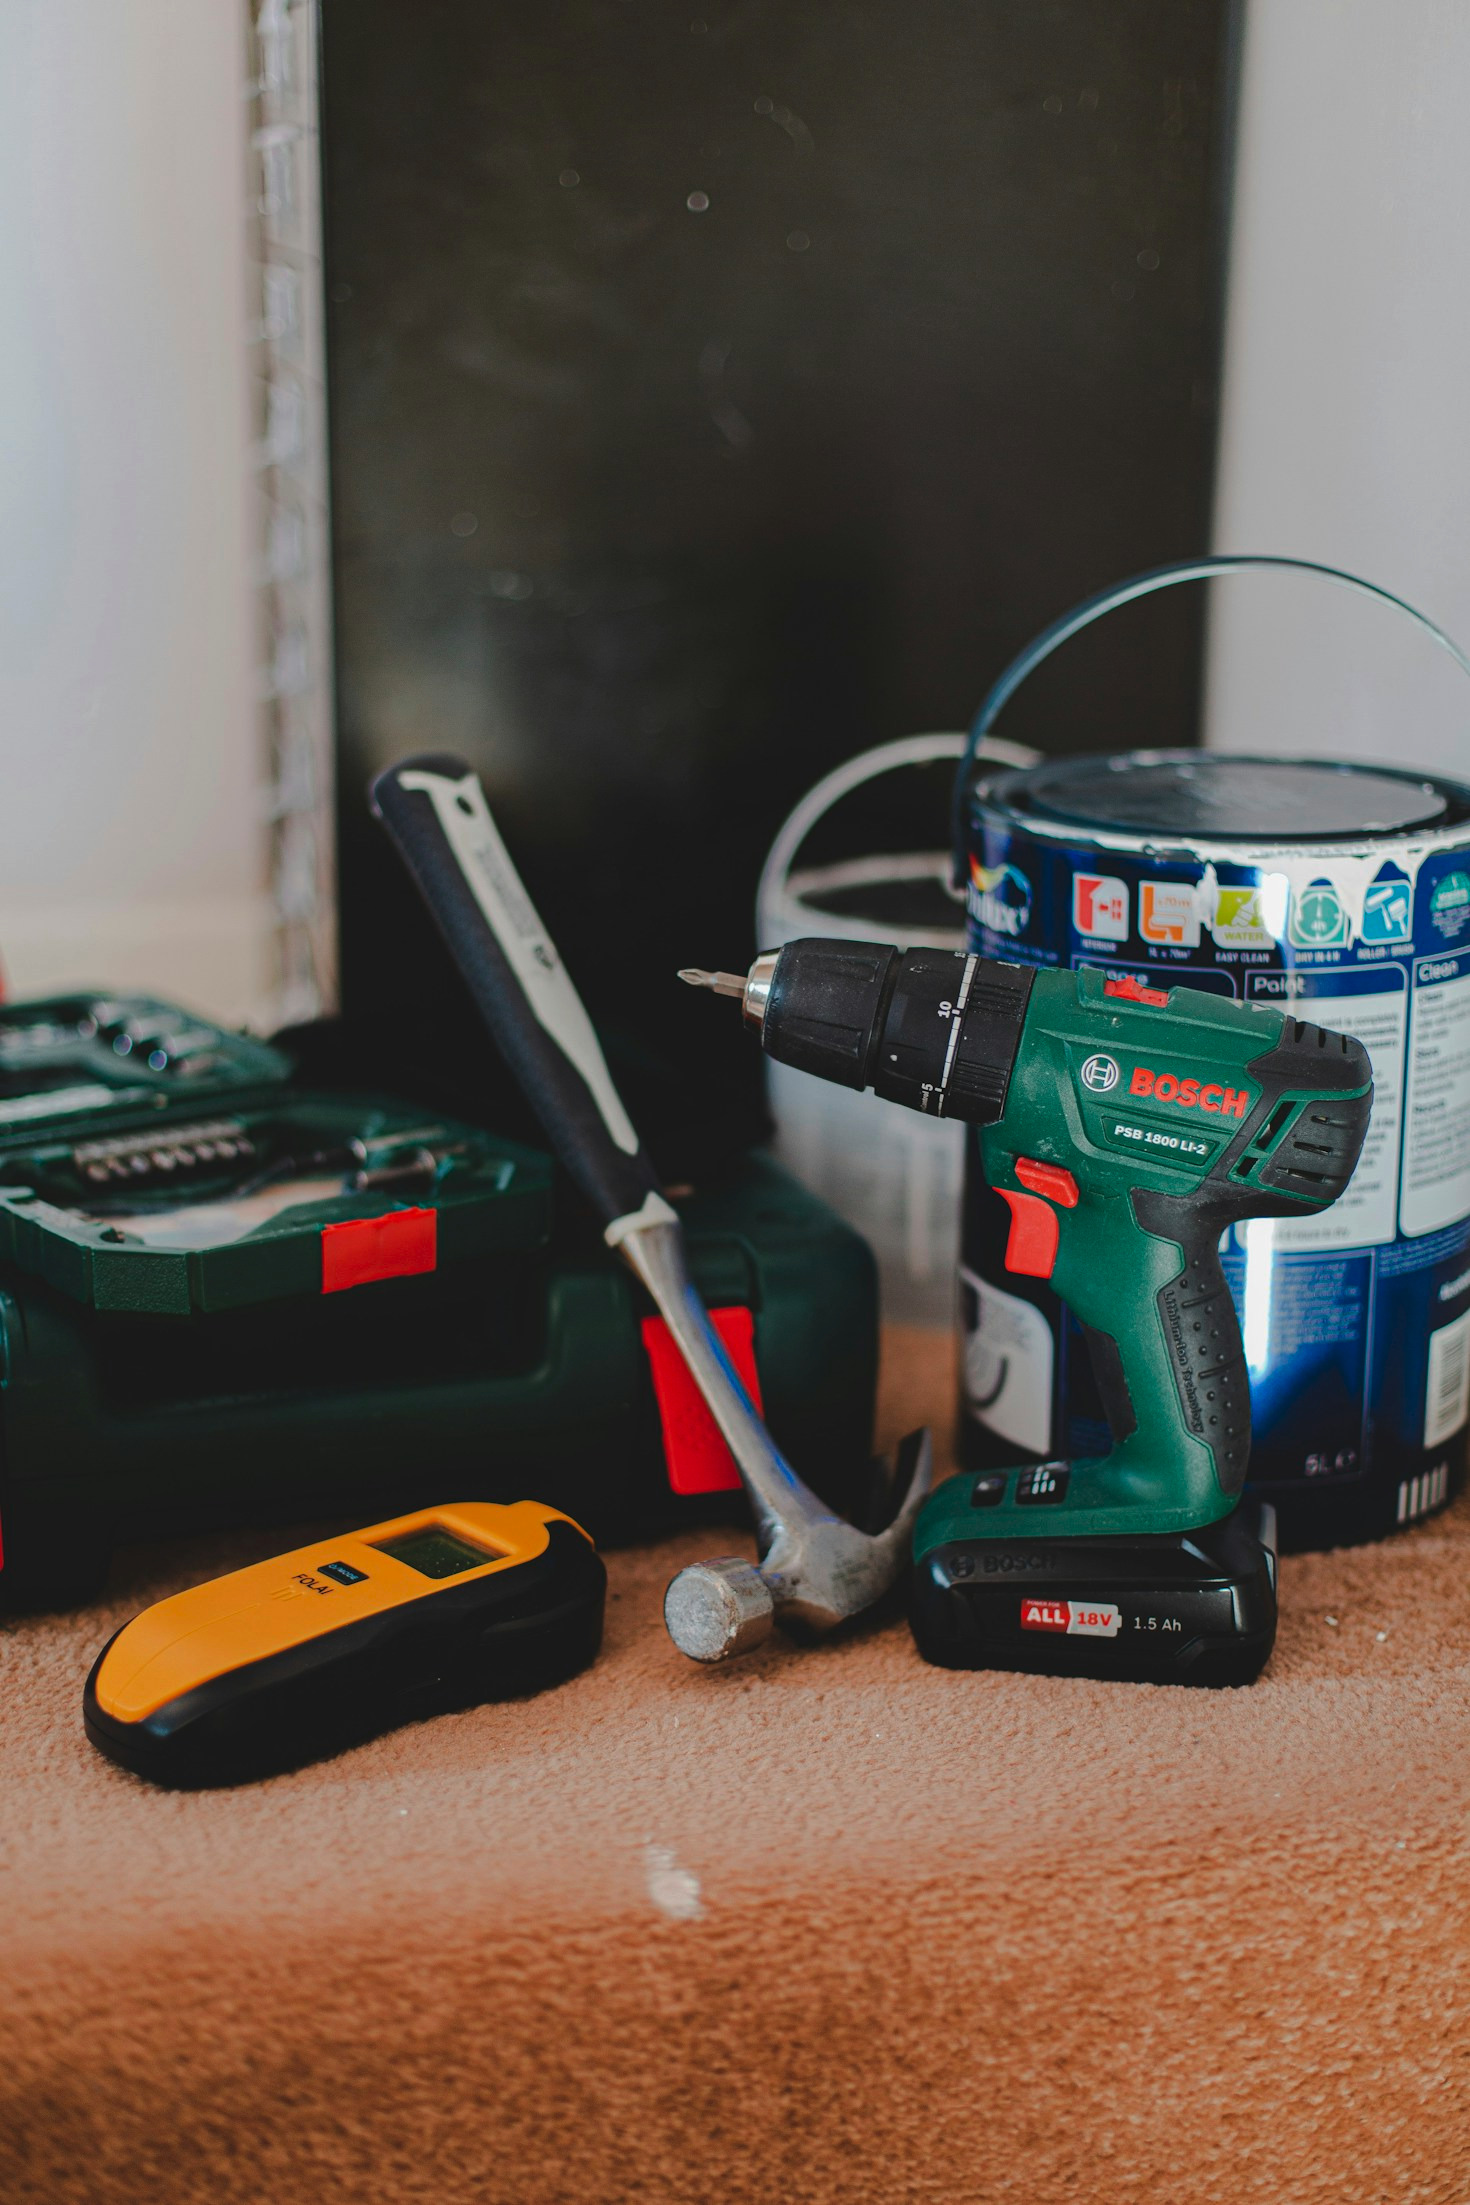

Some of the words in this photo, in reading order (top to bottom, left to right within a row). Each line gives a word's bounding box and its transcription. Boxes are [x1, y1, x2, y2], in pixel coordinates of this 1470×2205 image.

[1224, 932, 1264, 943] WATER
[1215, 952, 1237, 963] EASY
[1240, 952, 1270, 963] CLEAN
[1418, 960, 1459, 982] Clean
[1254, 974, 1306, 993] Paint
[937, 1001, 952, 1019] 10
[922, 1083, 933, 1092] 5
[1128, 1066, 1249, 1118] BOSCH
[1114, 1124, 1144, 1140] PSB
[1144, 1131, 1178, 1148] 1800
[1182, 1366, 1205, 1433] Technology
[983, 1552, 1057, 1573] BOSCH
[291, 1573, 335, 1595] FOLAI
[1026, 1607, 1065, 1625] ALL
[1077, 1612, 1113, 1627] 18V
[1133, 1617, 1157, 1630] 1.5
[1162, 1618, 1182, 1631] Ah
